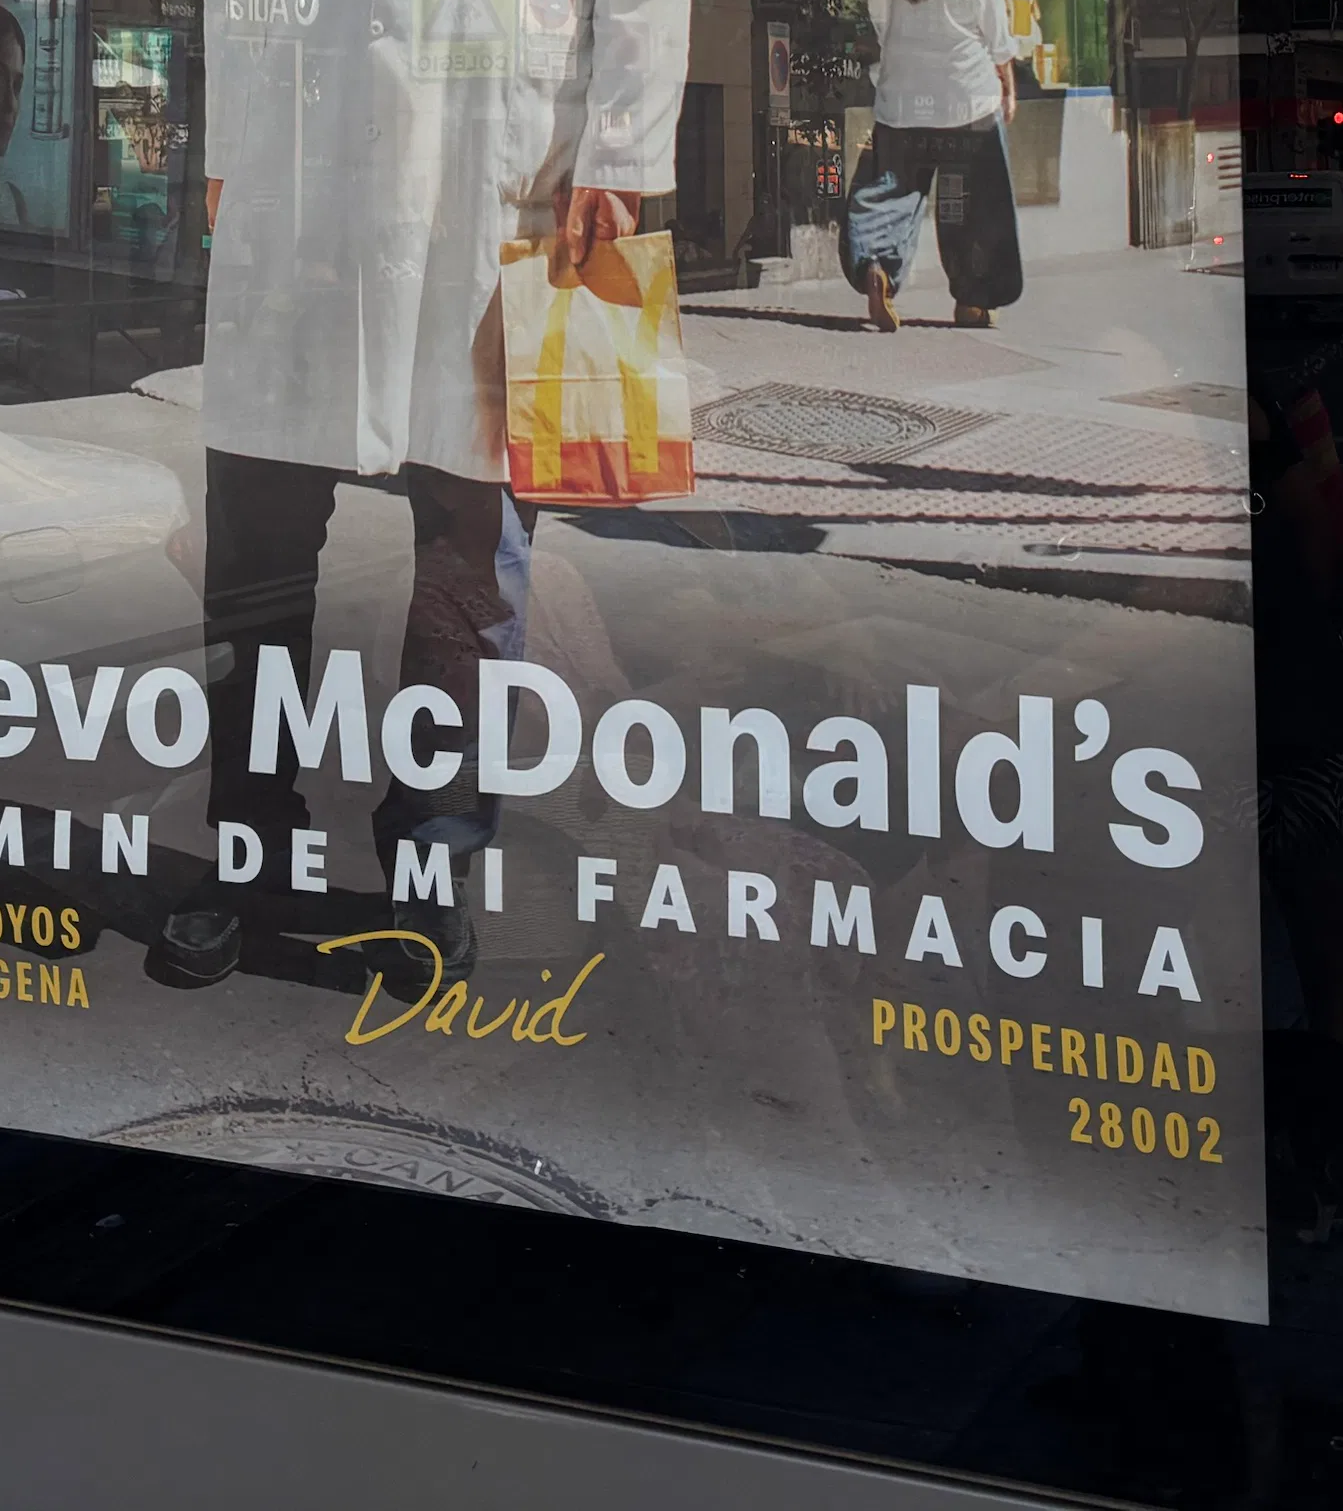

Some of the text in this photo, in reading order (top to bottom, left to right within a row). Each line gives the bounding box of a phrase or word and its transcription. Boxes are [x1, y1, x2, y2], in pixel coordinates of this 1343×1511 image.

[249, 644, 1205, 869] McDonald's
[218, 821, 327, 893] DE
[392, 839, 503, 912] MI
[577, 856, 1201, 1002] FARMACIA
[316, 930, 605, 1046] David
[872, 998, 1217, 1094] PROSPERIDAD
[1068, 1097, 1223, 1164] 28002
